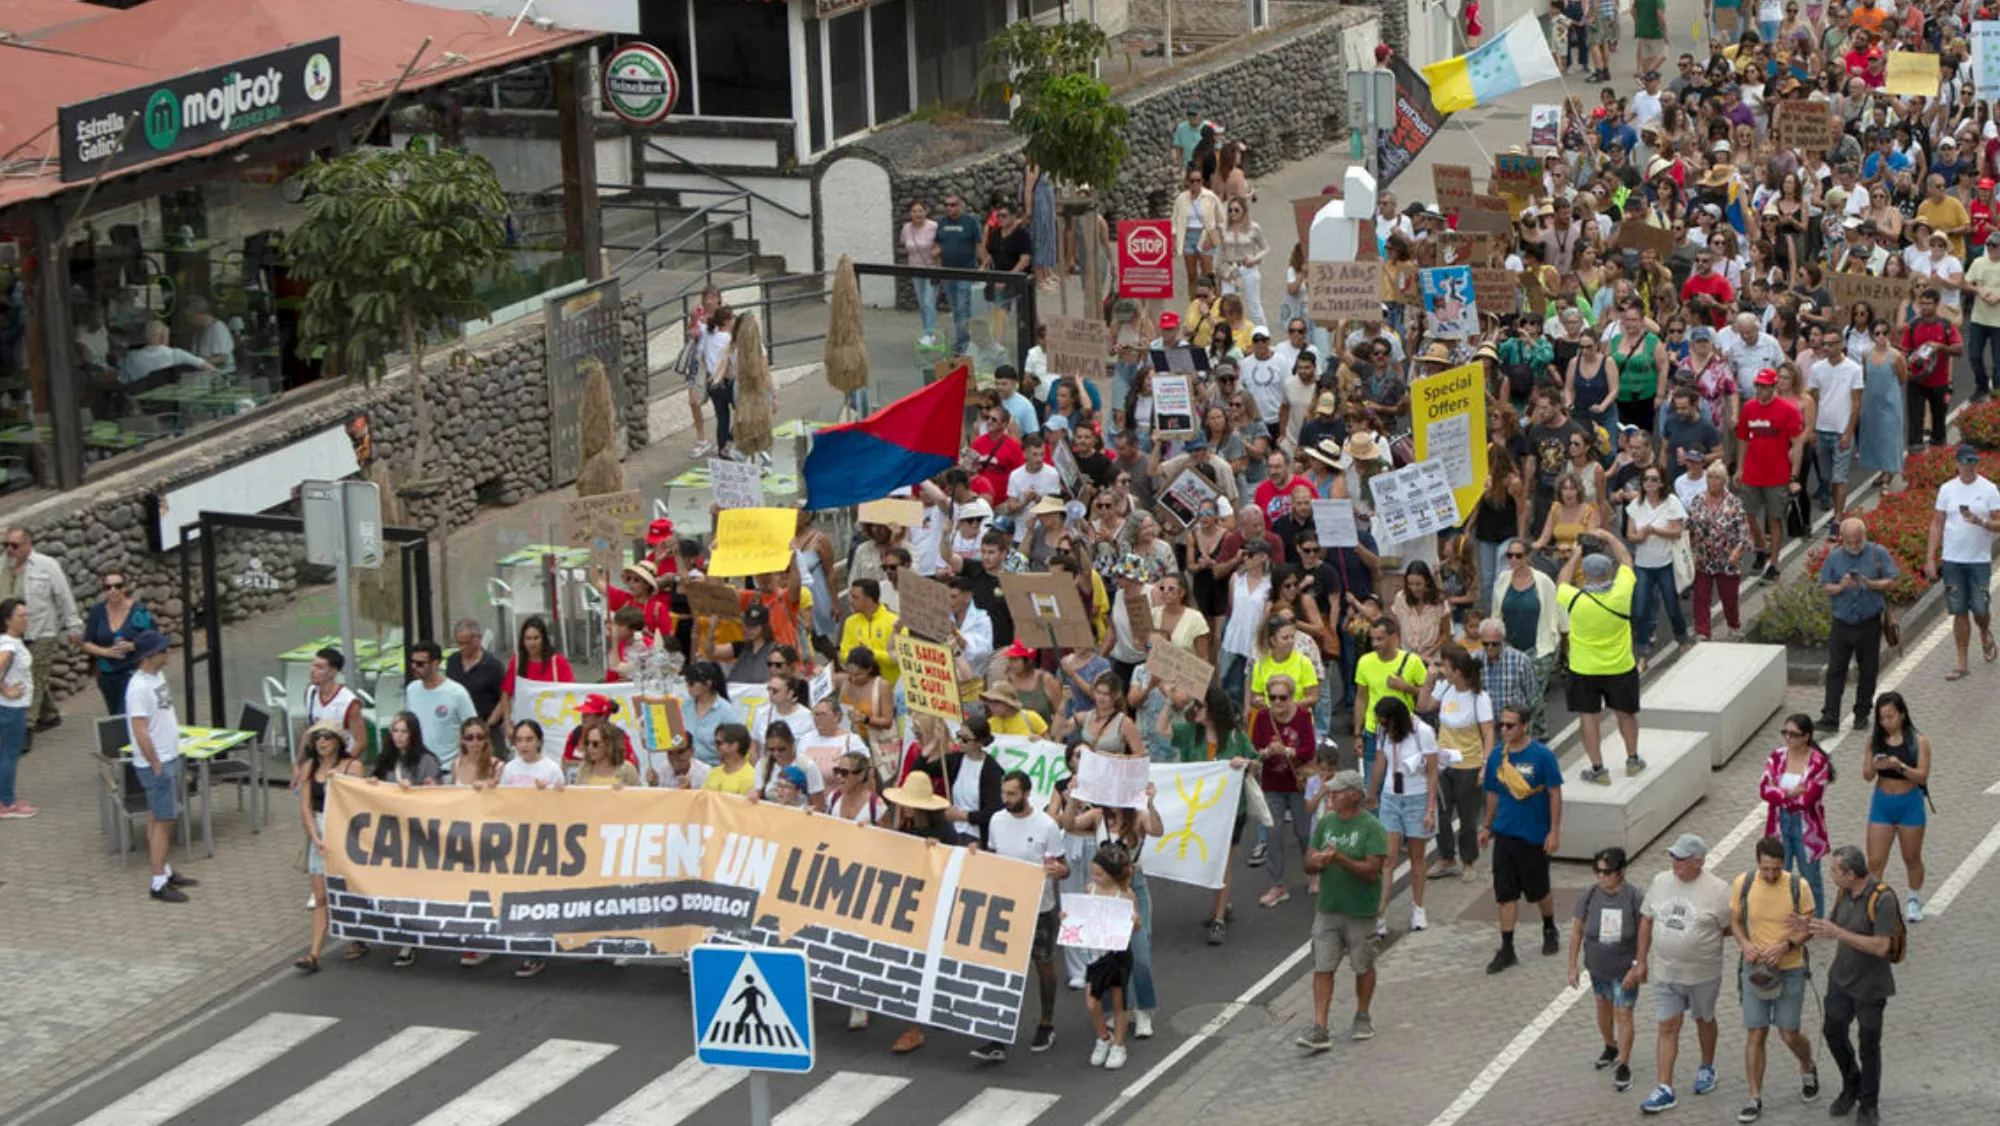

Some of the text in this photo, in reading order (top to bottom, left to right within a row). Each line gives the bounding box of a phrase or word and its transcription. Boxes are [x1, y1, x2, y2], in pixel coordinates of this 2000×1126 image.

[183, 66, 283, 130] mojito's
[77, 113, 124, 140] Estrella
[1132, 238, 1163, 254] STOP
[1423, 373, 1472, 402] Special
[1427, 395, 1470, 419] Offers
[915, 644, 947, 667] BARRIO
[345, 812, 588, 877] CANARIAS
[714, 831, 779, 897] UN
[777, 841, 926, 934] LÍMITE
[562, 901, 592, 919] UN
[594, 894, 678, 916] CAMBIO
